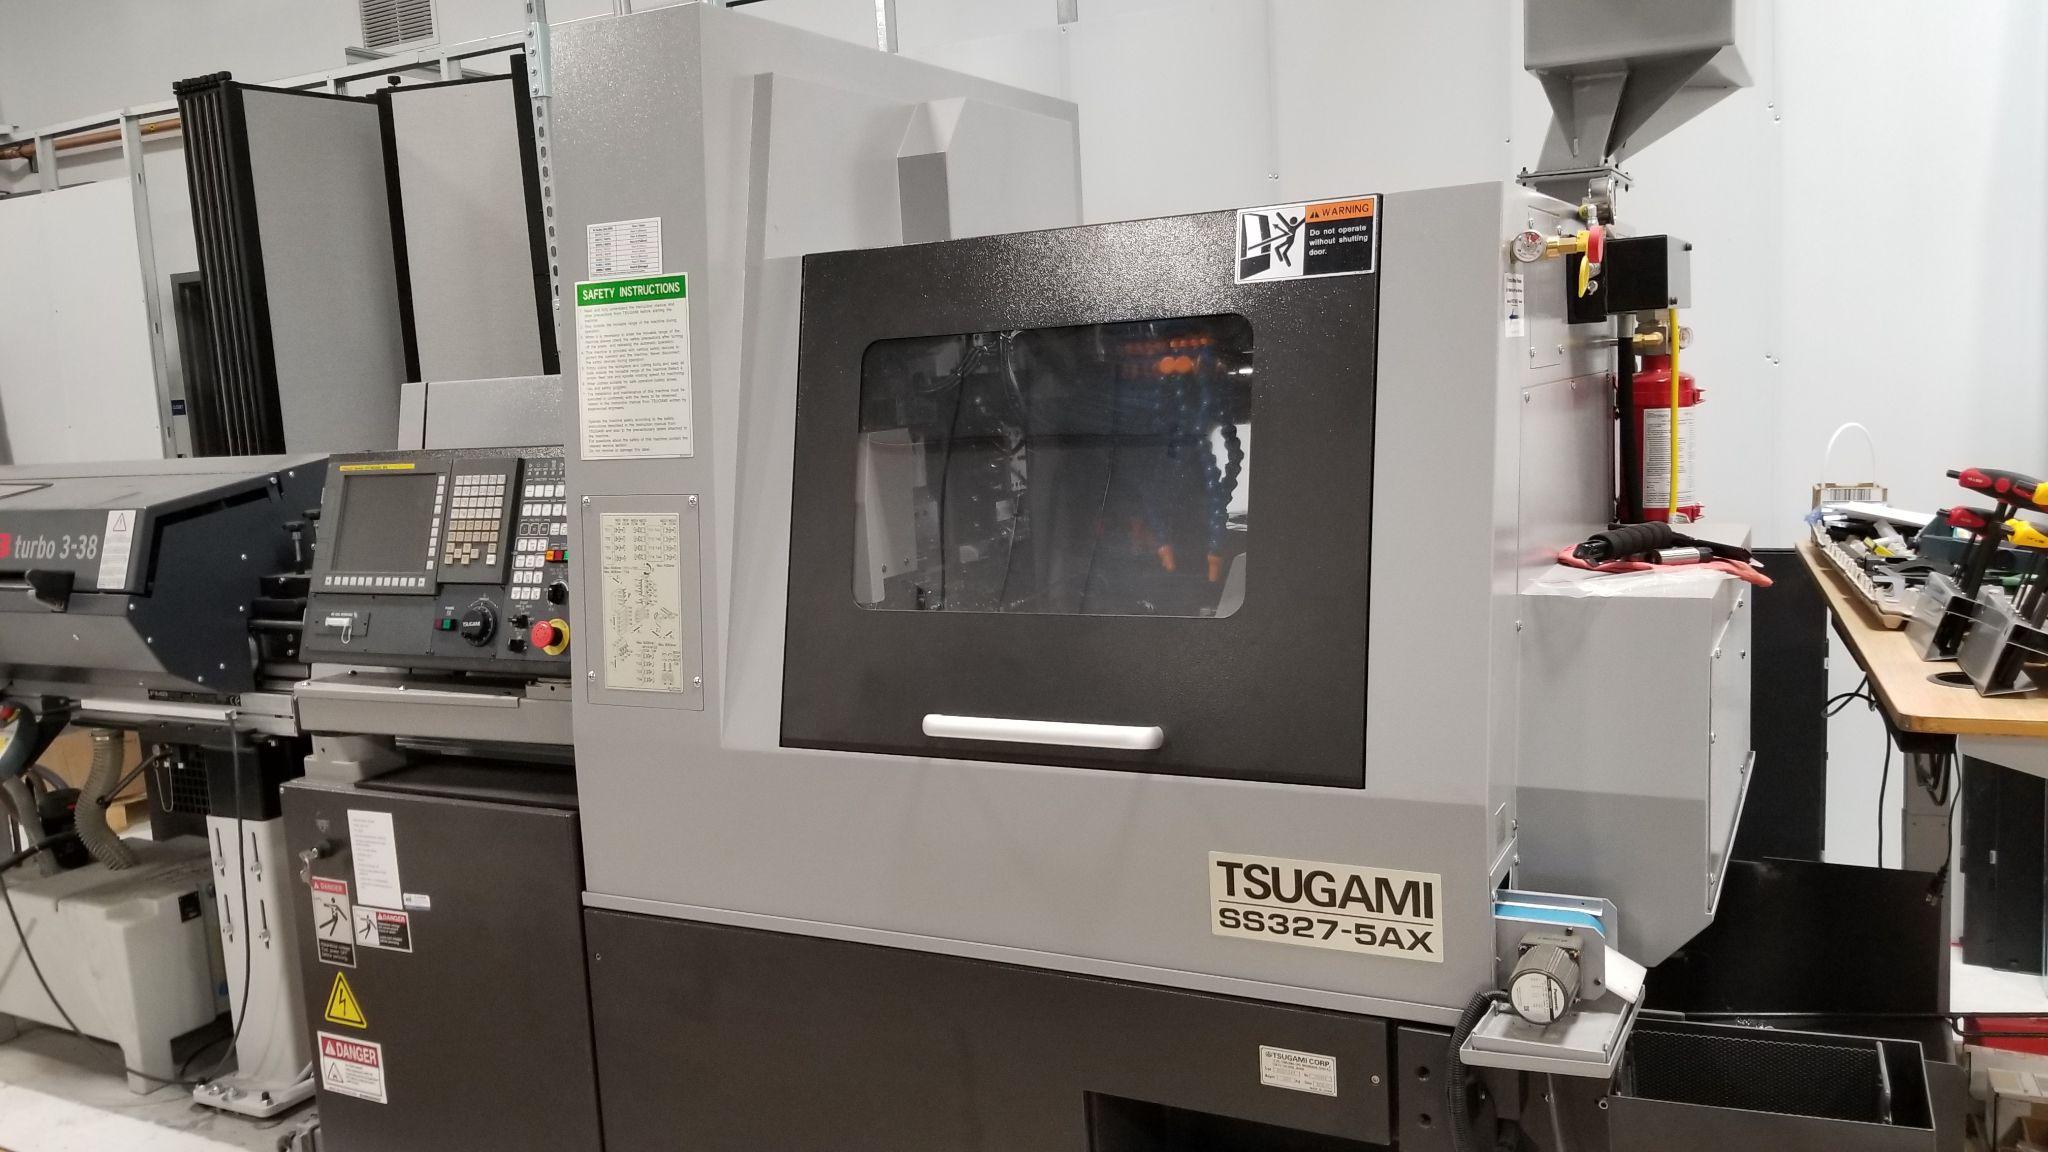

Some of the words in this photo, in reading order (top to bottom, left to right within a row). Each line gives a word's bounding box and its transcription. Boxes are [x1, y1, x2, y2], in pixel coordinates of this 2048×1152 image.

[1322, 203, 1369, 217] WARNING
[1309, 228, 1320, 237] Do
[1323, 226, 1335, 235] not
[1337, 224, 1367, 234] operate
[1309, 236, 1336, 246] without
[1338, 234, 1368, 244] shutting
[1309, 248, 1327, 256] door.
[582, 287, 615, 301] SAFETY
[619, 281, 681, 298] INSTRUCTIONS
[14, 534, 56, 560] turbo
[59, 534, 98, 560] 3-38
[1216, 860, 1434, 919] TSUGAMI
[1218, 907, 1434, 953] SS327-5AX
[335, 1040, 378, 1066] DANGER
[1273, 1052, 1308, 1064] TSUGAMI
